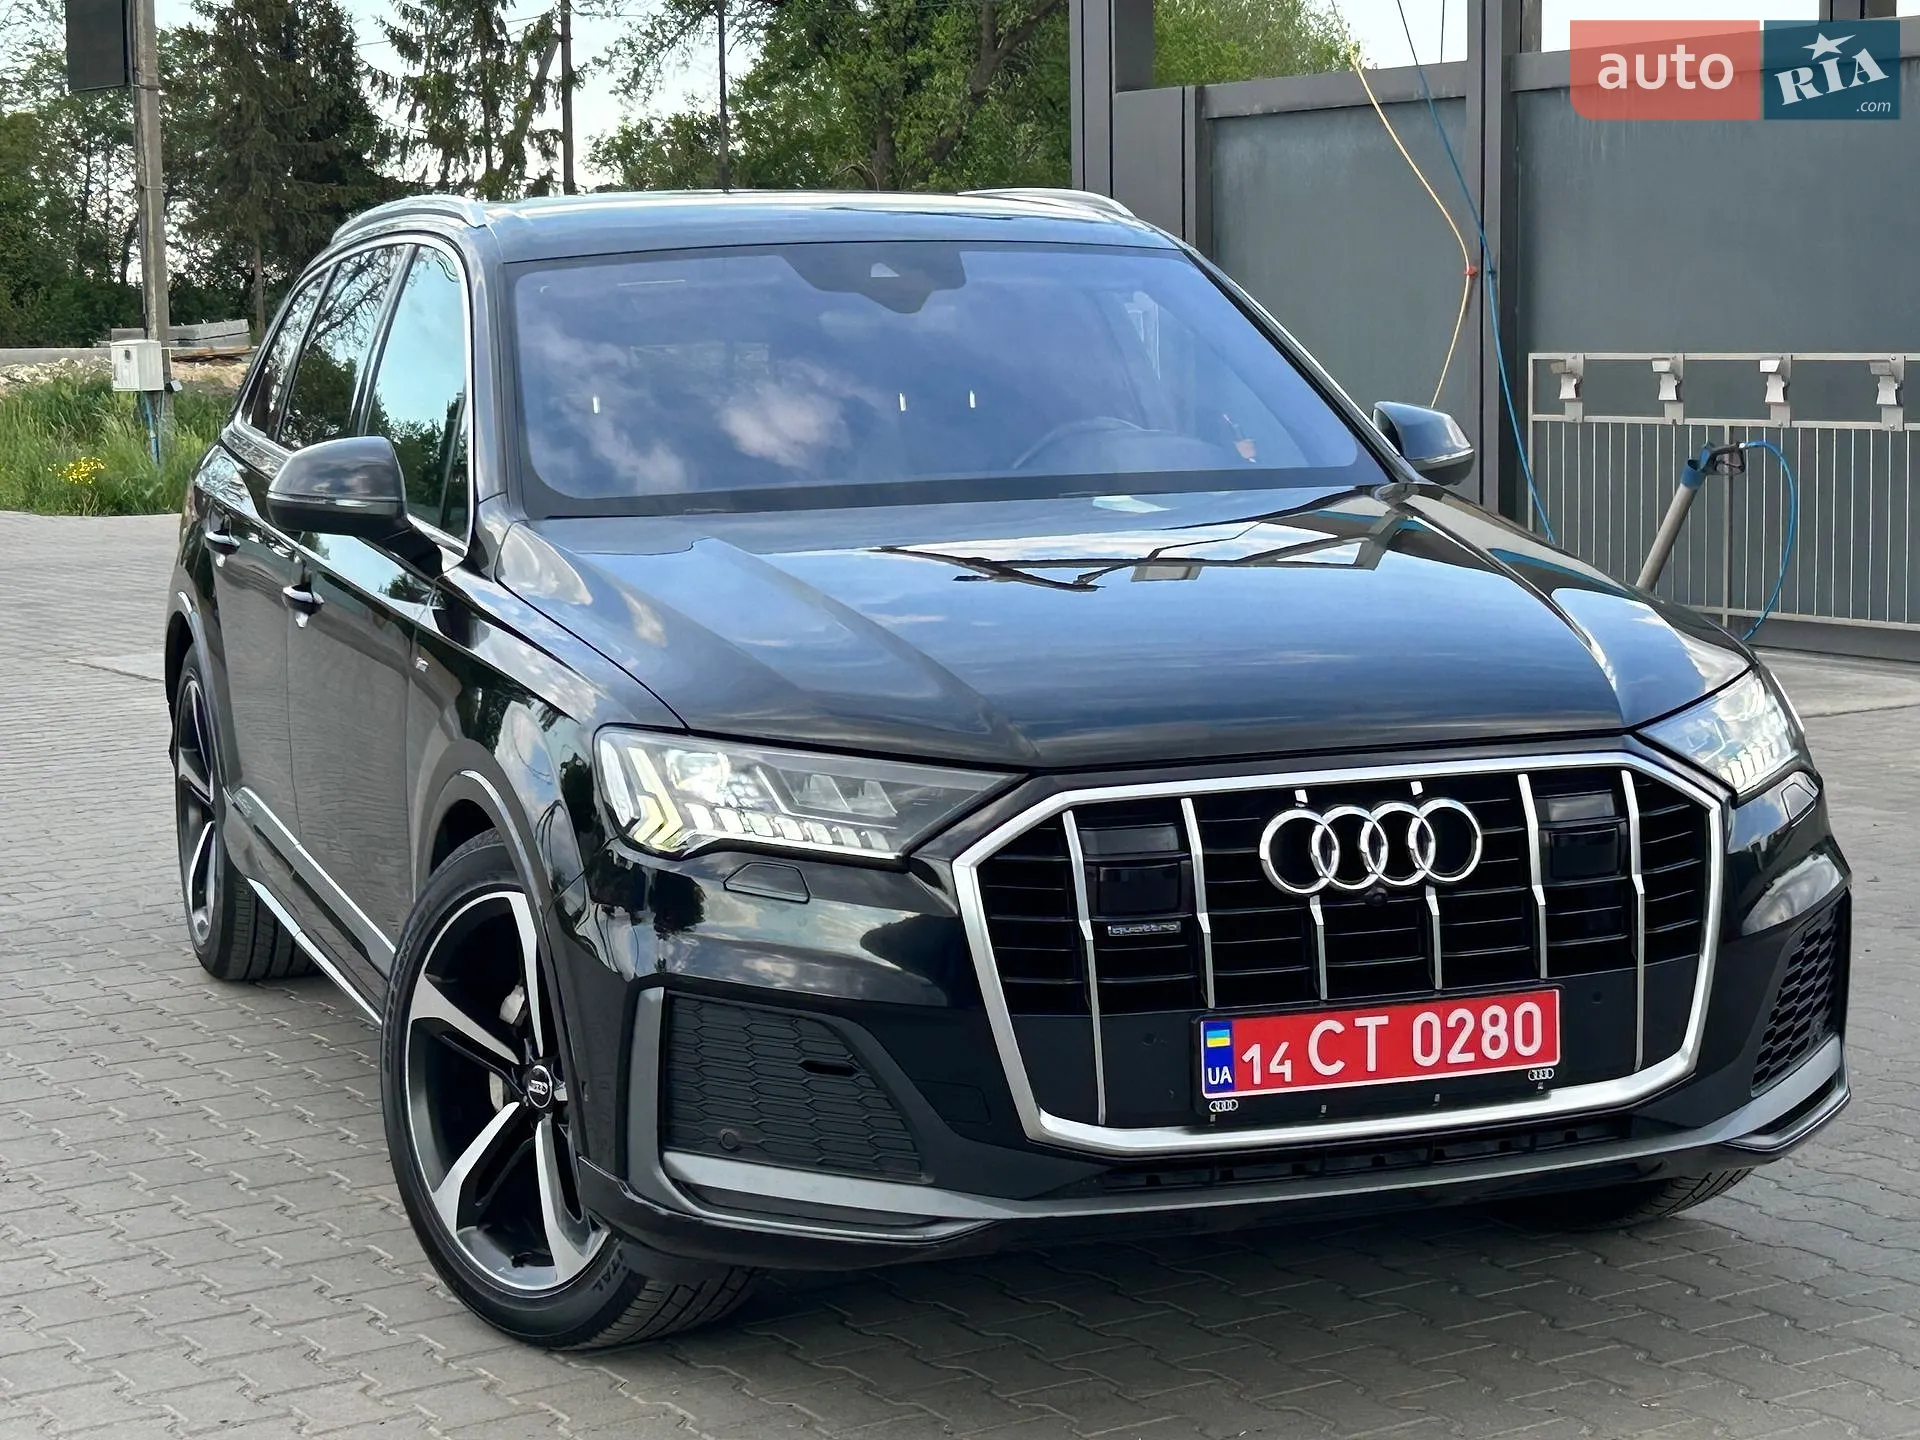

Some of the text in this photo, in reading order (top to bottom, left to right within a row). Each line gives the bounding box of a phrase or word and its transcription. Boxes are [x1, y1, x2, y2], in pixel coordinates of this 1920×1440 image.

[1241, 1001, 1543, 1085] 14 CT 0280
[1207, 1066, 1233, 1085] UA
